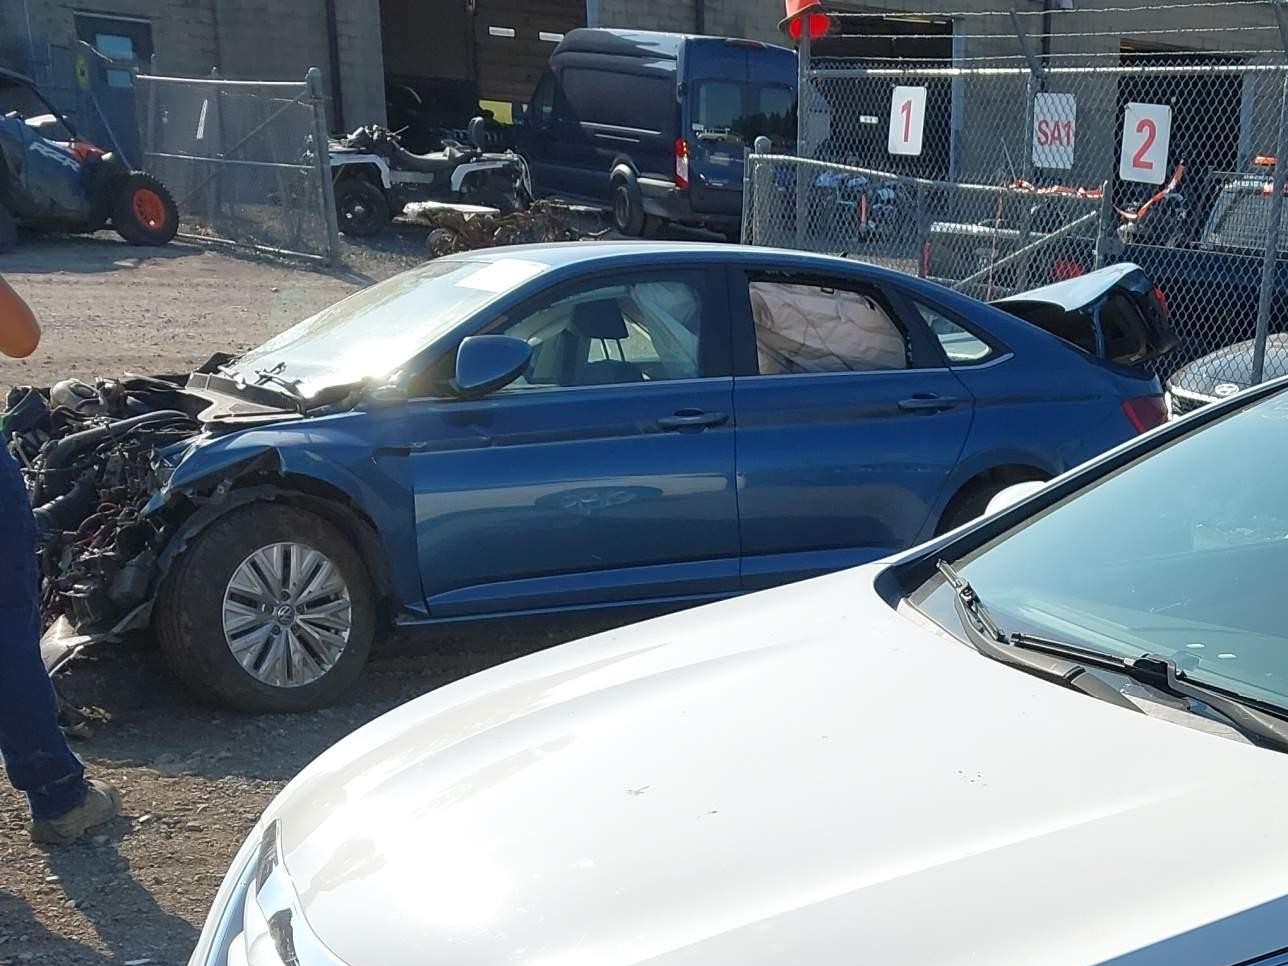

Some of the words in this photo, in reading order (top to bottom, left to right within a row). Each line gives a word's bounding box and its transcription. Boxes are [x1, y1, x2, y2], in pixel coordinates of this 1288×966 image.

[901, 101, 913, 142] 1
[1036, 120, 1072, 146] SA1
[1132, 118, 1157, 169] 2
